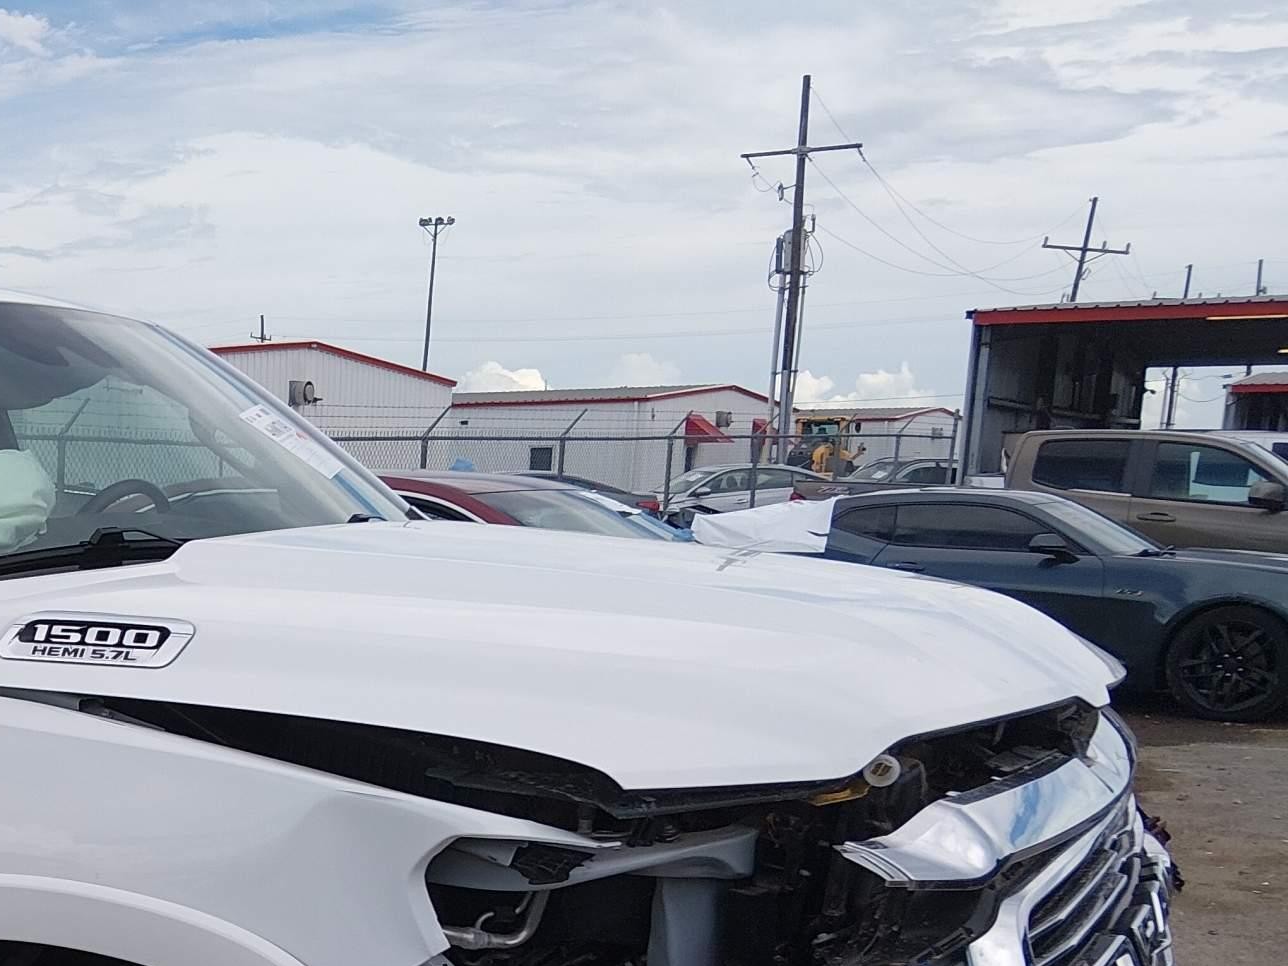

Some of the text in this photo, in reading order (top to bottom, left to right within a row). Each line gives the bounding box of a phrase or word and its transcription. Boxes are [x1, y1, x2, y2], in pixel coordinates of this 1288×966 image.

[33, 624, 160, 647] 1500
[31, 646, 137, 661] HEMI 5.7L
